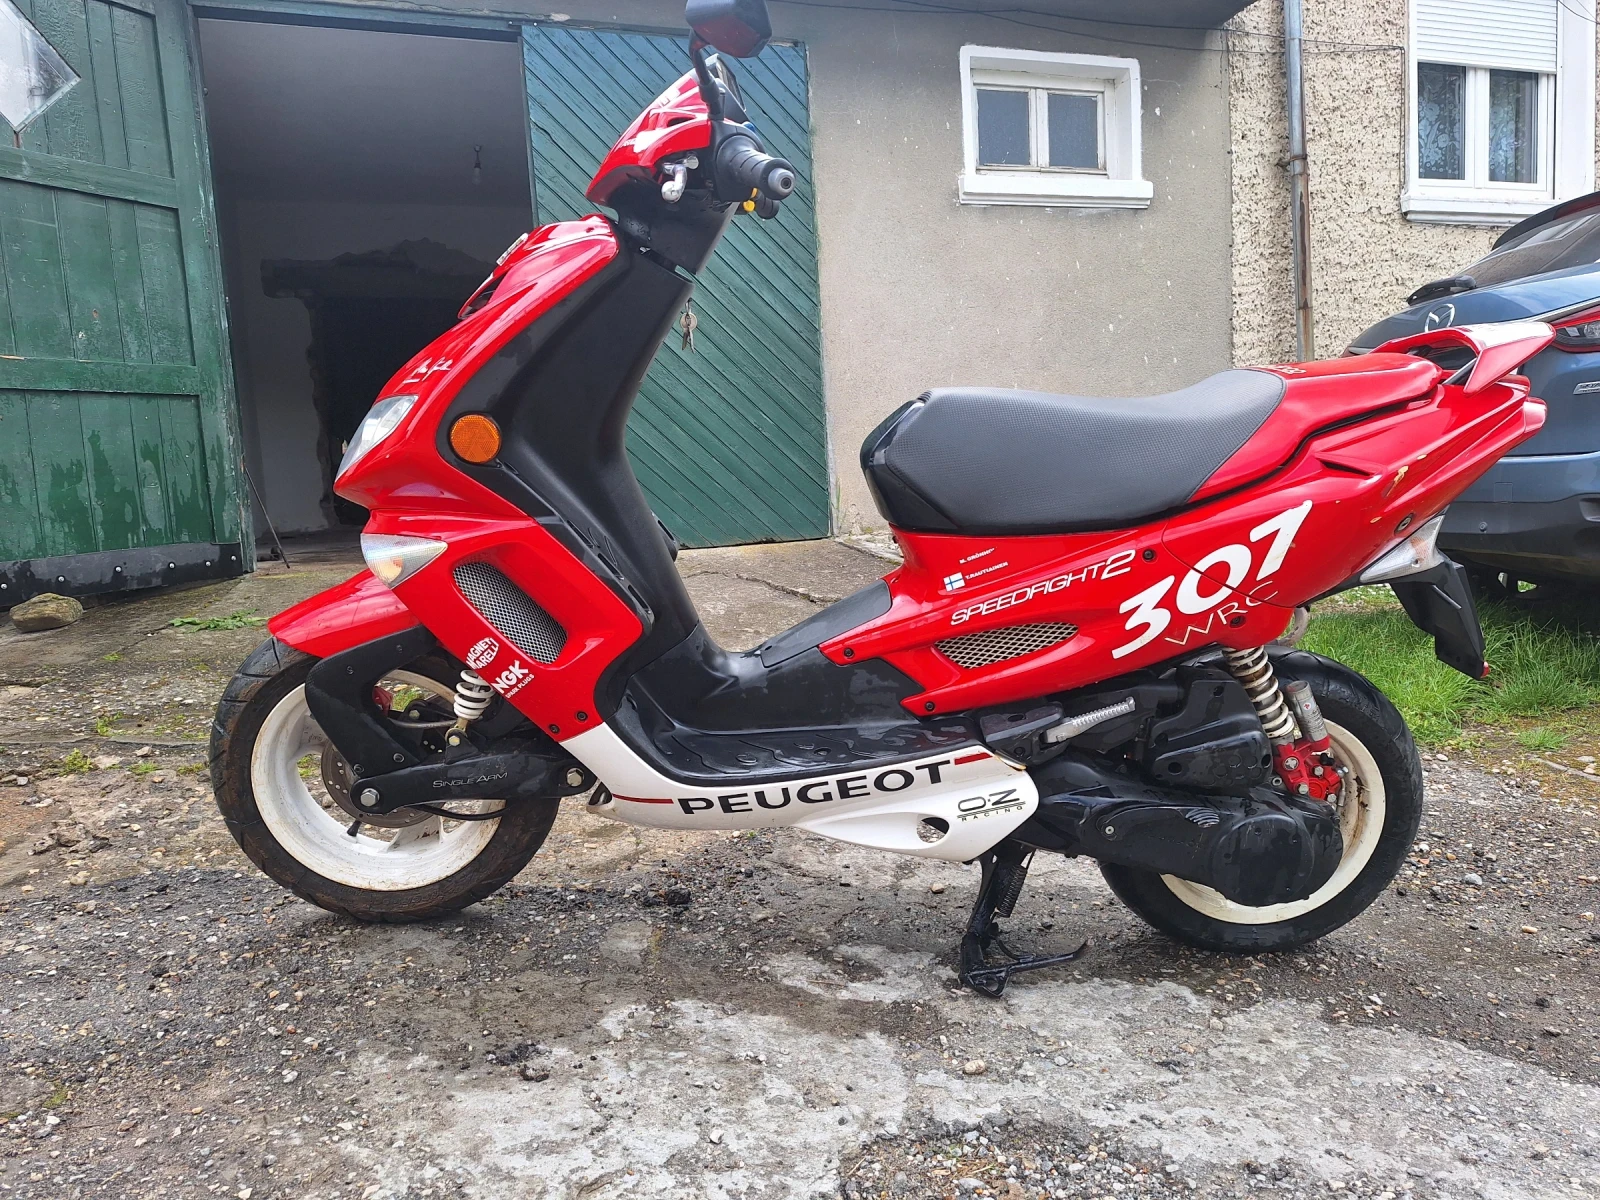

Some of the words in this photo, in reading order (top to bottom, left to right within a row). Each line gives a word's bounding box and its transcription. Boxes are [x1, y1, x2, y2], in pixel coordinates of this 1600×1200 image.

[1112, 500, 1313, 660] 307
[1164, 580, 1278, 646] WRC
[466, 637, 494, 664] MAGNETI
[491, 660, 529, 694] NGK
[505, 685, 520, 699] SPARK
[517, 674, 535, 689] PLUGS
[433, 778, 475, 788] SINGLE
[476, 772, 508, 783] ARM
[676, 759, 951, 815] PEUGEOT
[961, 805, 1023, 822] RACING
